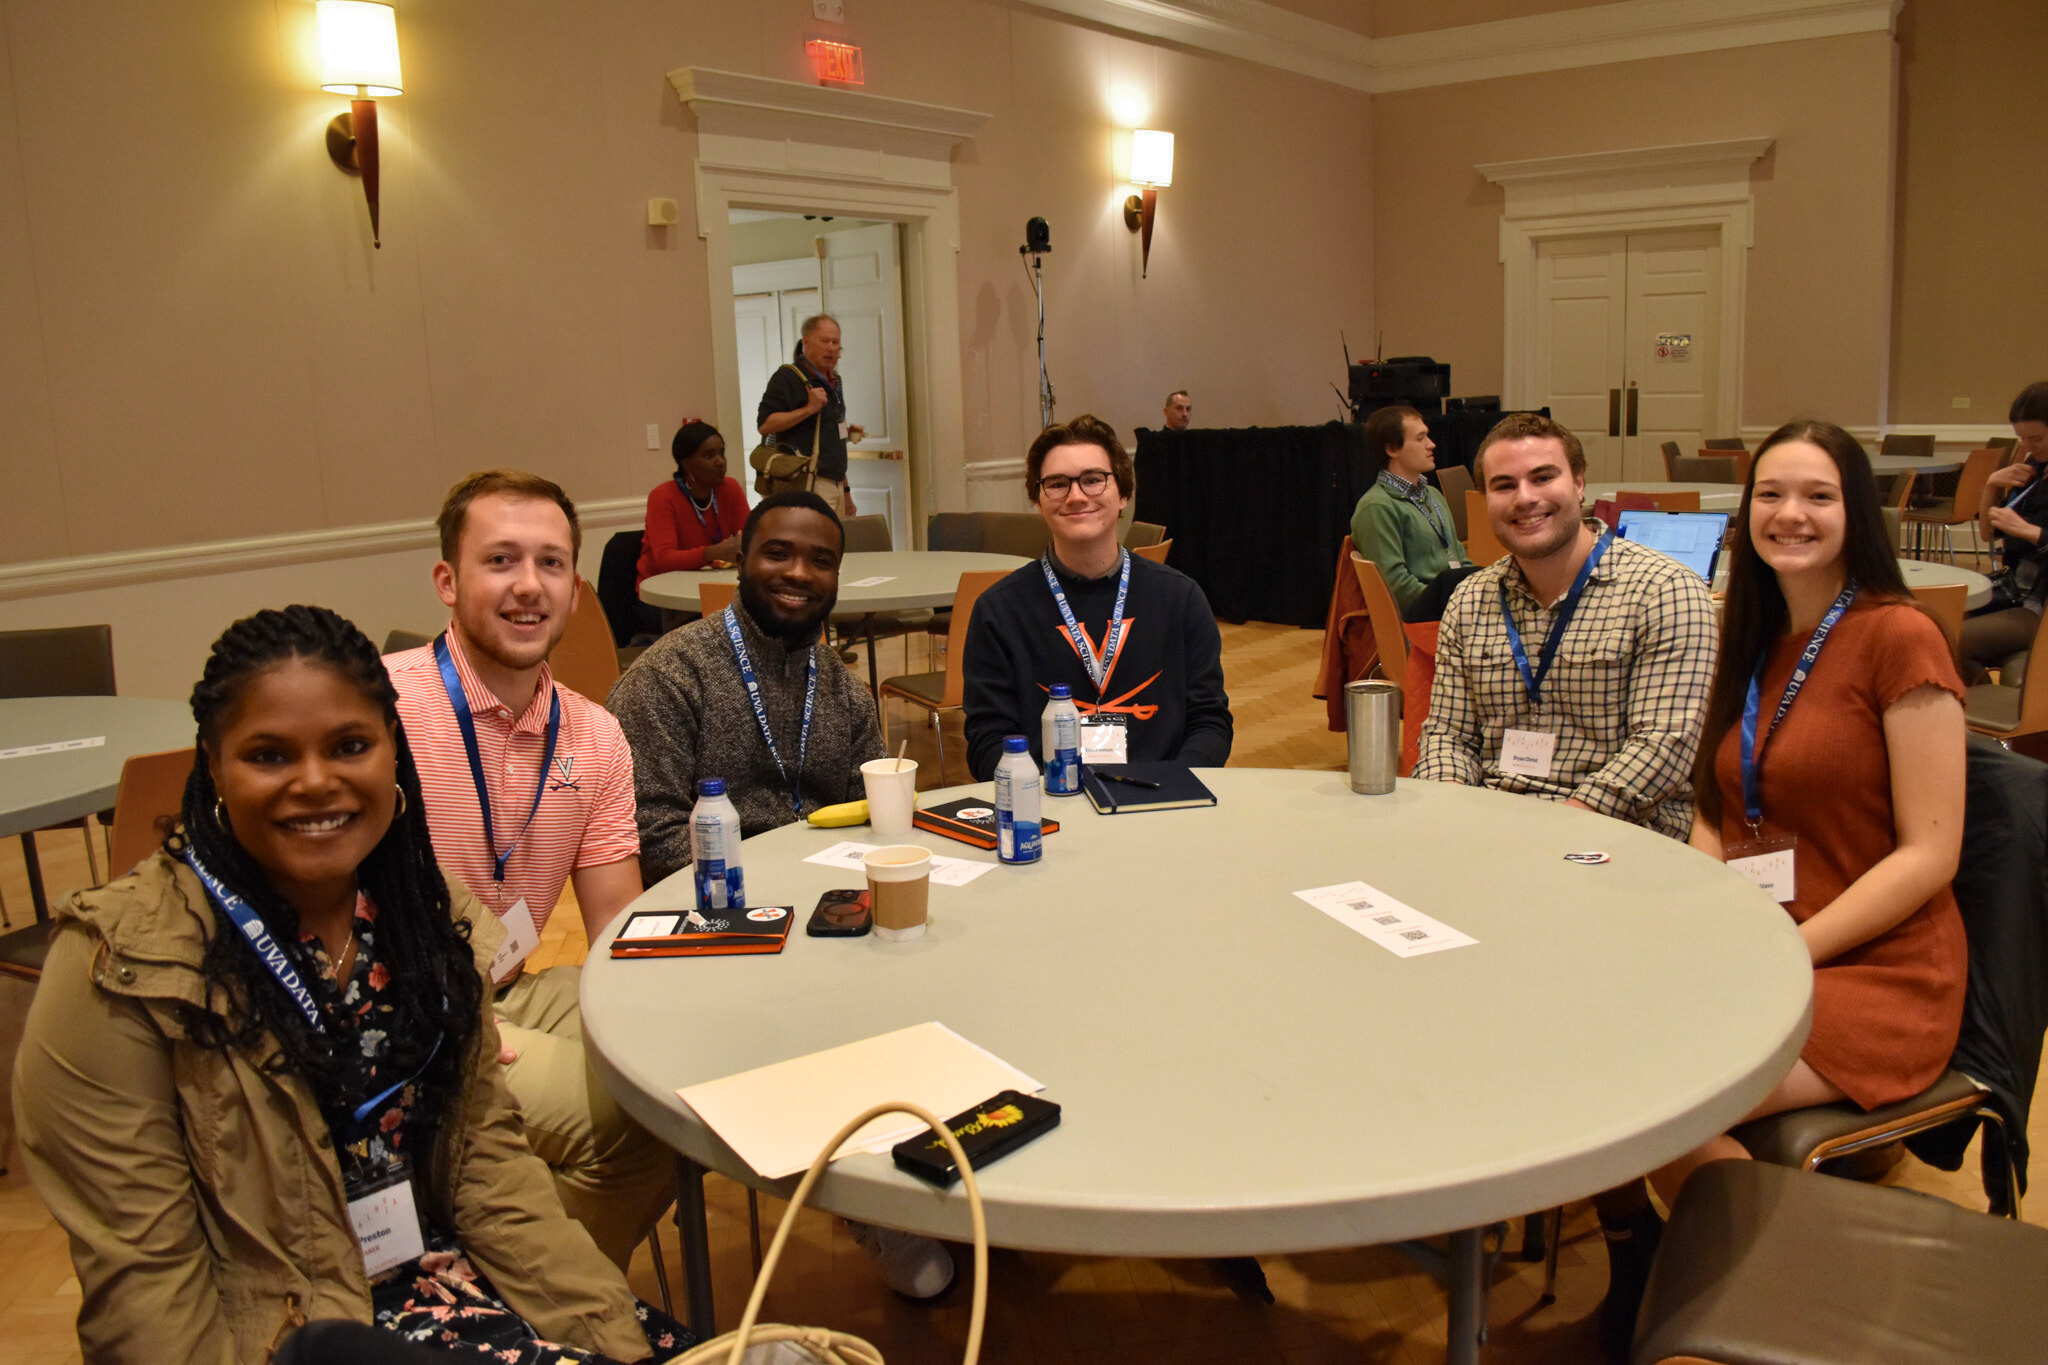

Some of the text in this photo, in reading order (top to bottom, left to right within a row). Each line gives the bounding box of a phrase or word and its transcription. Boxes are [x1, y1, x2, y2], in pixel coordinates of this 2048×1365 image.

[826, 46, 855, 80] EXIT
[1059, 600, 1072, 620] UVA
[1066, 617, 1083, 642] DATA
[1113, 586, 1128, 628] SCIENCE
[730, 625, 752, 674] SCIENCE
[1108, 627, 1119, 652] DATA
[1802, 609, 1841, 663] SCIENCE
[750, 691, 764, 713] UVA
[804, 674, 817, 722] SCIENCE
[1781, 681, 1801, 705] UVA
[756, 714, 773, 745] DATA
[256, 934, 319, 1024] UVA DATA
[359, 1227, 391, 1245] Preston
